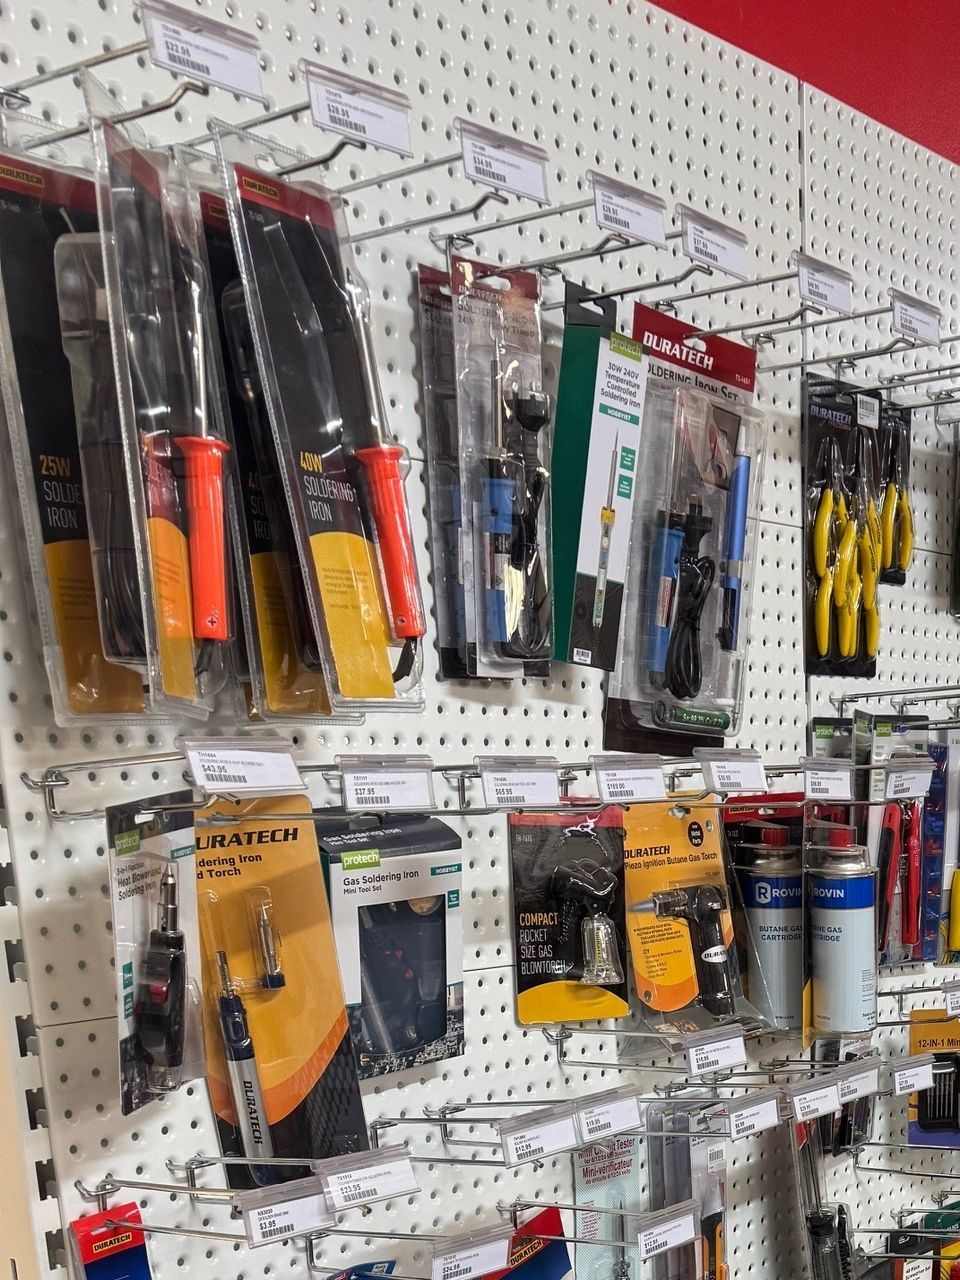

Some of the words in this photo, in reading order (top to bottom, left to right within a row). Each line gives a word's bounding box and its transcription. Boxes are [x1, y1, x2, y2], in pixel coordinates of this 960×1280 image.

[642, 331, 714, 371] DURATECH
[608, 362, 623, 374] 30W
[623, 367, 640, 380] 240V
[605, 371, 641, 391] Temperature
[606, 382, 637, 398] Controlled
[600, 388, 629, 408] Soldering
[629, 398, 641, 409] Iron
[40, 455, 71, 478] 25W
[300, 451, 323, 474] 40W
[304, 475, 355, 503] SOLDERING
[47, 507, 78, 530] IRON
[309, 500, 334, 523] IRON
[201, 764, 228, 774] $43.95
[354, 787, 376, 796] $37.95
[196, 827, 299, 851] URATECH
[238, 853, 263, 865] Iron
[344, 851, 379, 868] protech
[624, 845, 671, 860] DURATECH
[624, 861, 642, 871] Piezo
[642, 858, 666, 870] Ignition
[666, 856, 688, 866] Butane
[688, 853, 701, 863] Gas
[701, 851, 718, 861] Torch
[117, 874, 132, 888] Heat
[132, 871, 151, 884] Blower
[208, 867, 242, 879] Torch
[343, 875, 360, 886] Gas
[362, 871, 402, 884] Soldering
[403, 869, 419, 880] Iron
[118, 884, 145, 901] Soldering
[343, 887, 357, 895] Mini
[358, 885, 371, 894] Tool
[372, 884, 382, 892] Set
[813, 887, 845, 898] ROVIN
[519, 912, 559, 927] COMPACT
[519, 928, 548, 943] POCKET
[759, 925, 789, 933] BUTANE
[826, 926, 843, 934] GAS
[761, 934, 802, 942] CARTRIDGE
[521, 943, 536, 959] SIZE
[537, 943, 554, 959] GAS
[521, 960, 567, 976] BLOWTORCH
[918, 1038, 945, 1048] 12-IN-1
[243, 1080, 263, 1145] DURATECH
[617, 1137, 635, 1151] Tester
[340, 1183, 362, 1195] $23.95
[259, 1220, 277, 1231] $3.95
[93, 1233, 131, 1252] DURATECH
[510, 1240, 542, 1266] DURATECH
